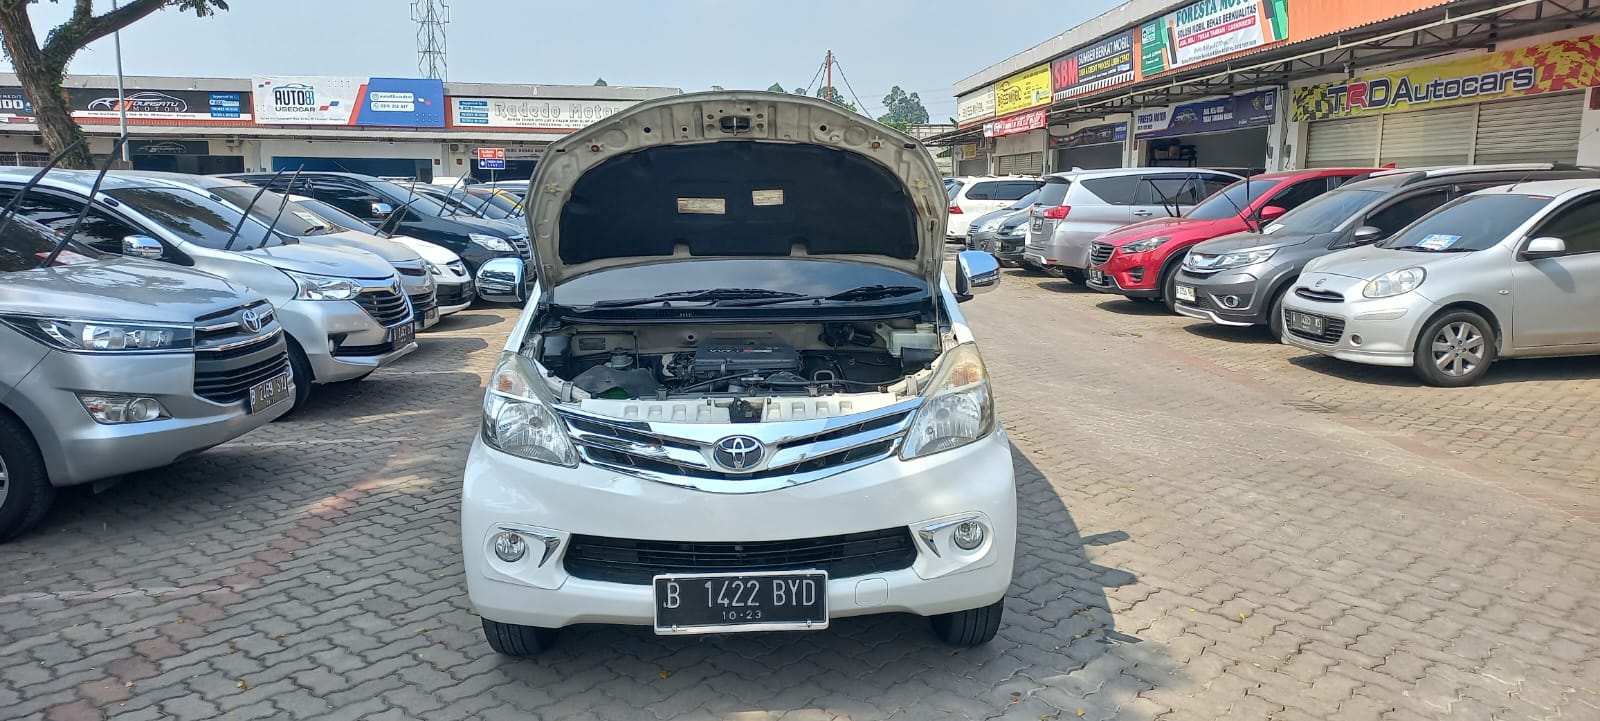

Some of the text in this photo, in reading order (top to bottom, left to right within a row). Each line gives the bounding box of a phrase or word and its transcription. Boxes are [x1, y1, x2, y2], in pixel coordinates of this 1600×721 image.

[1176, 0, 1218, 27] FORESTA
[1177, 25, 1191, 39] SOLUSI
[1206, 16, 1222, 29] BEKAS
[1222, 4, 1257, 24] BERKUALITAS
[1078, 36, 1130, 65] SUMBER BERKAT MOBIL
[1054, 54, 1078, 89] SBM
[1327, 66, 1536, 113] TRD Autocars
[495, 101, 561, 119] Radedo
[666, 579, 816, 609] B 1422 BYD
